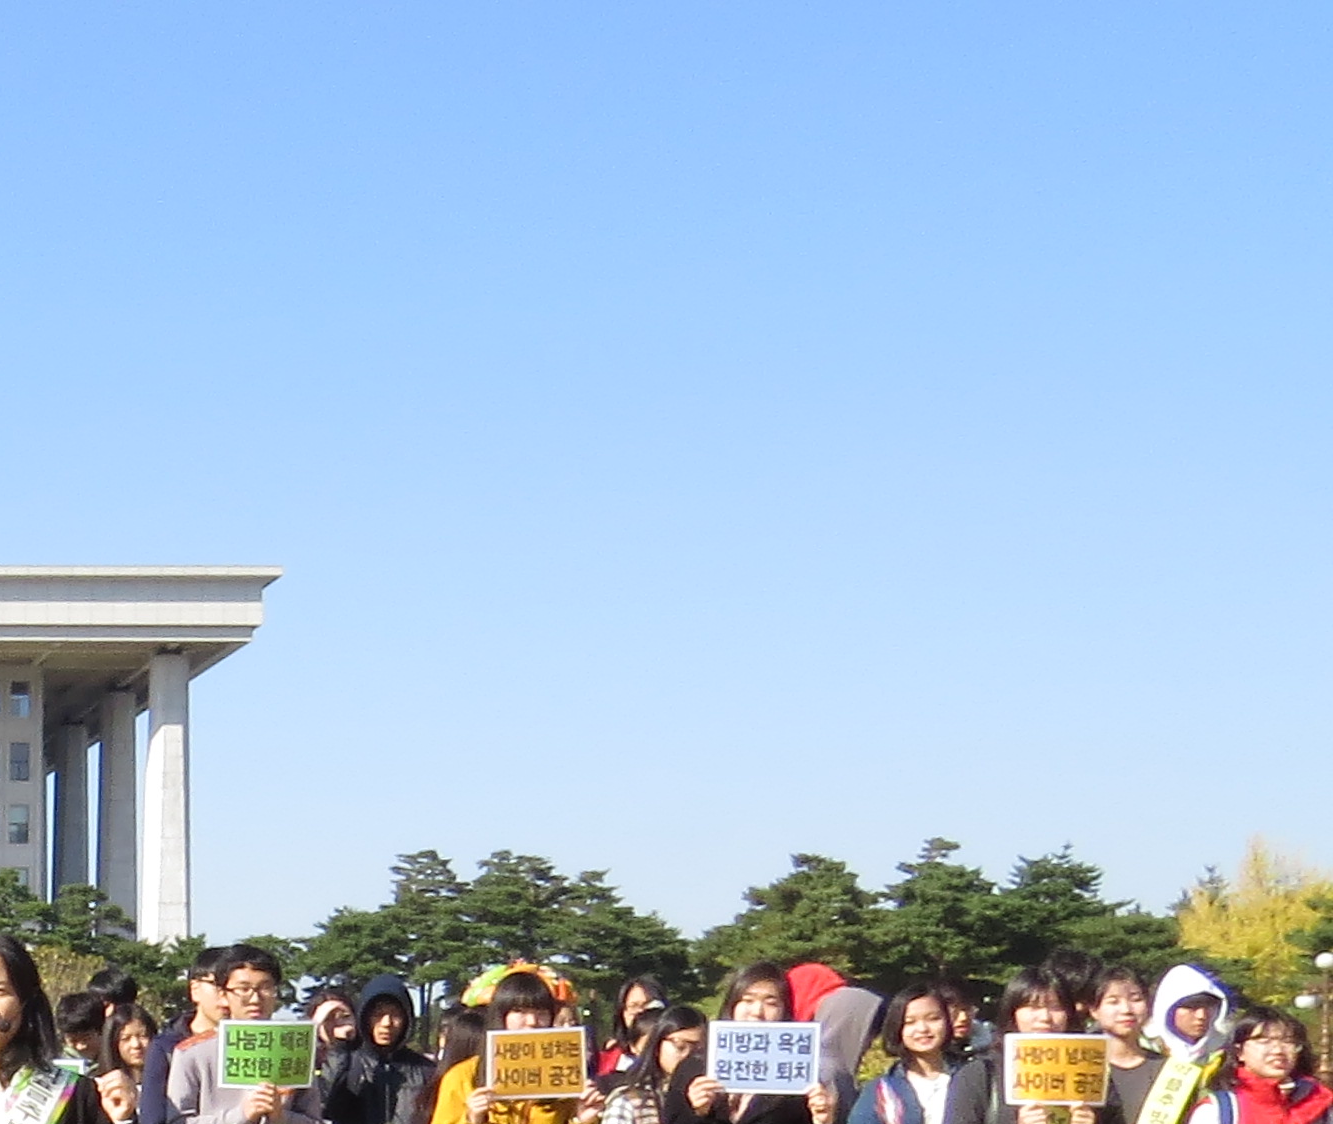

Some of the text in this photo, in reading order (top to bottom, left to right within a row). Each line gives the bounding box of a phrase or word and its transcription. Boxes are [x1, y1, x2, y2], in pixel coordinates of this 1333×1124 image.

[225, 1030, 275, 1051] 나눔과
[495, 1041, 536, 1060] 사랑이
[717, 1032, 812, 1054] 비방과 욕설
[1013, 1046, 1060, 1065] 사랑이
[225, 1056, 272, 1078] 건전한
[495, 1065, 581, 1088] 사이버 공간
[715, 1059, 811, 1083] 완전한 퇴치
[1014, 1072, 1103, 1094] 사이버 공간
